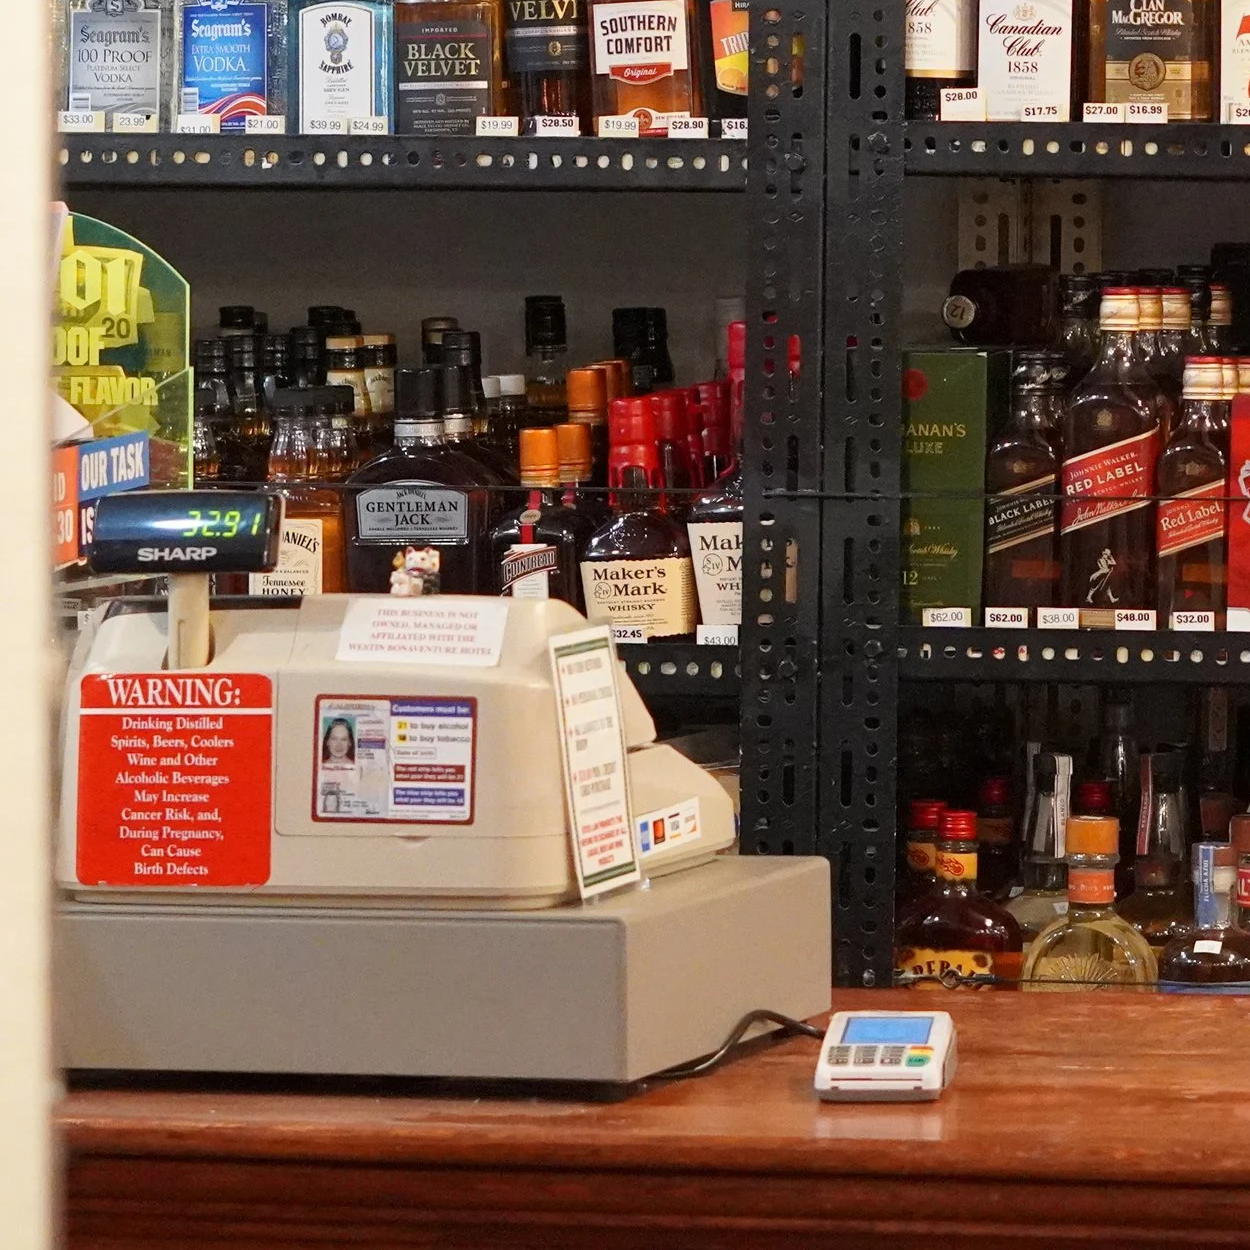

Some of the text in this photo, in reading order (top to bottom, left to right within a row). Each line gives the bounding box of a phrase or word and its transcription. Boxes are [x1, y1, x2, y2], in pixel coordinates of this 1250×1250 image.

[319, 12, 352, 27] BOMBAY
[600, 15, 677, 36] SOUTHERN
[985, 13, 1063, 36] Canadian
[408, 42, 476, 60] BLACK
[606, 35, 673, 55] COMFORT
[192, 55, 248, 72] VODKA
[93, 72, 133, 83] VODKA
[945, 90, 978, 102] $28.00
[1085, 105, 1118, 116] $27.00
[1129, 105, 1163, 115] $16.99
[247, 119, 279, 130] $21.00
[309, 120, 341, 131] $39.99
[352, 121, 384, 131] $24.99
[481, 119, 513, 130] $19.99
[541, 118, 574, 128] $28.50
[671, 119, 704, 130] $28.90
[70, 377, 158, 406] FLAVOR
[81, 442, 145, 492] OUR TASK
[365, 500, 459, 513] GENTLEMAN
[394, 512, 430, 527] JACK
[137, 547, 218, 562] SHARP
[593, 566, 667, 581] Maker's
[613, 582, 666, 597] Mark
[608, 603, 656, 612] WHISKY
[930, 611, 963, 622] $62.00
[1116, 612, 1150, 623] $48.00
[106, 678, 241, 707] WARNING:
[122, 717, 223, 731] Drinking Distilled
[110, 735, 235, 750] Spirits, Beers, Coolers
[127, 753, 219, 767] Wine and Other
[114, 771, 230, 787] Alcoholic Beverages
[134, 790, 210, 805] May Increase
[121, 808, 222, 823] Cancer Risk, and,
[119, 827, 224, 843] During Pregnancy,
[140, 845, 202, 857] Can Cause
[134, 863, 208, 876] Birth Defects
